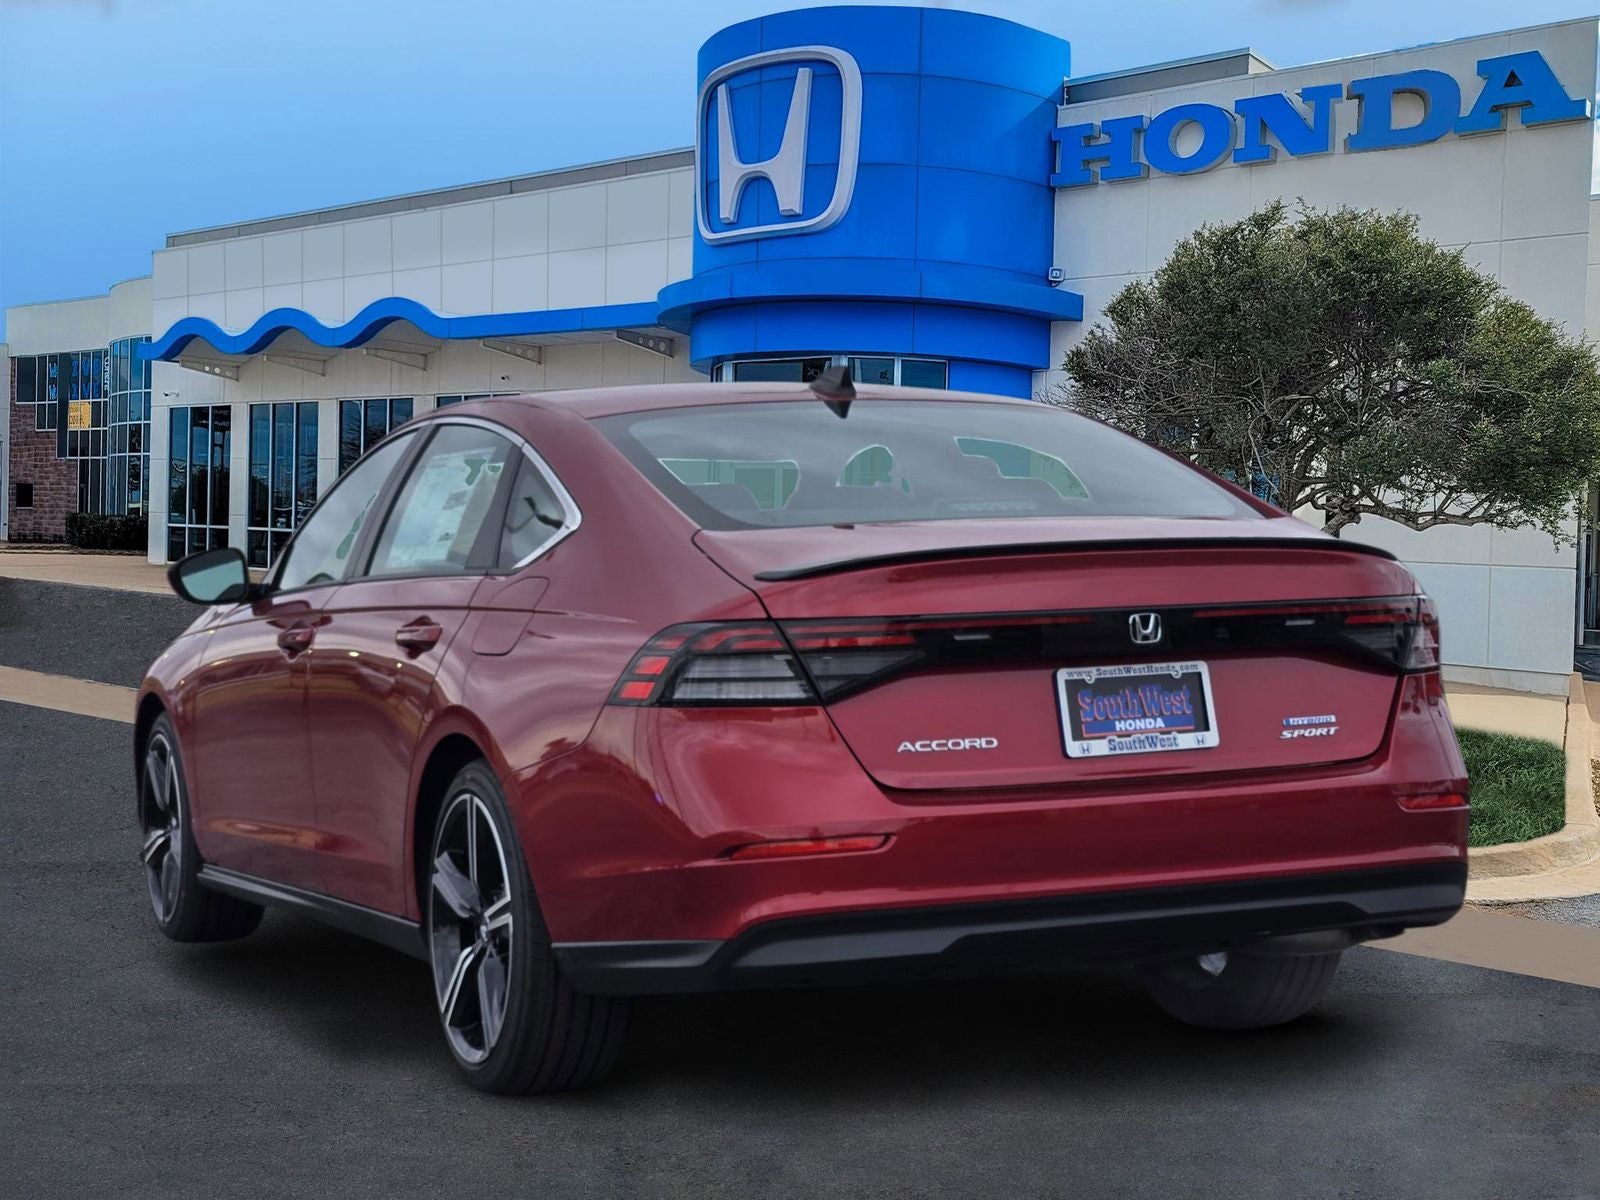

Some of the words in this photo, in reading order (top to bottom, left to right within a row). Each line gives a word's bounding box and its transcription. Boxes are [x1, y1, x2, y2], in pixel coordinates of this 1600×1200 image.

[1051, 50, 1591, 187] HONDA
[1115, 717, 1165, 732] HONDA
[1280, 726, 1339, 739] SPORT
[897, 737, 999, 753] ACCORD
[1107, 734, 1179, 752] SouthWest
